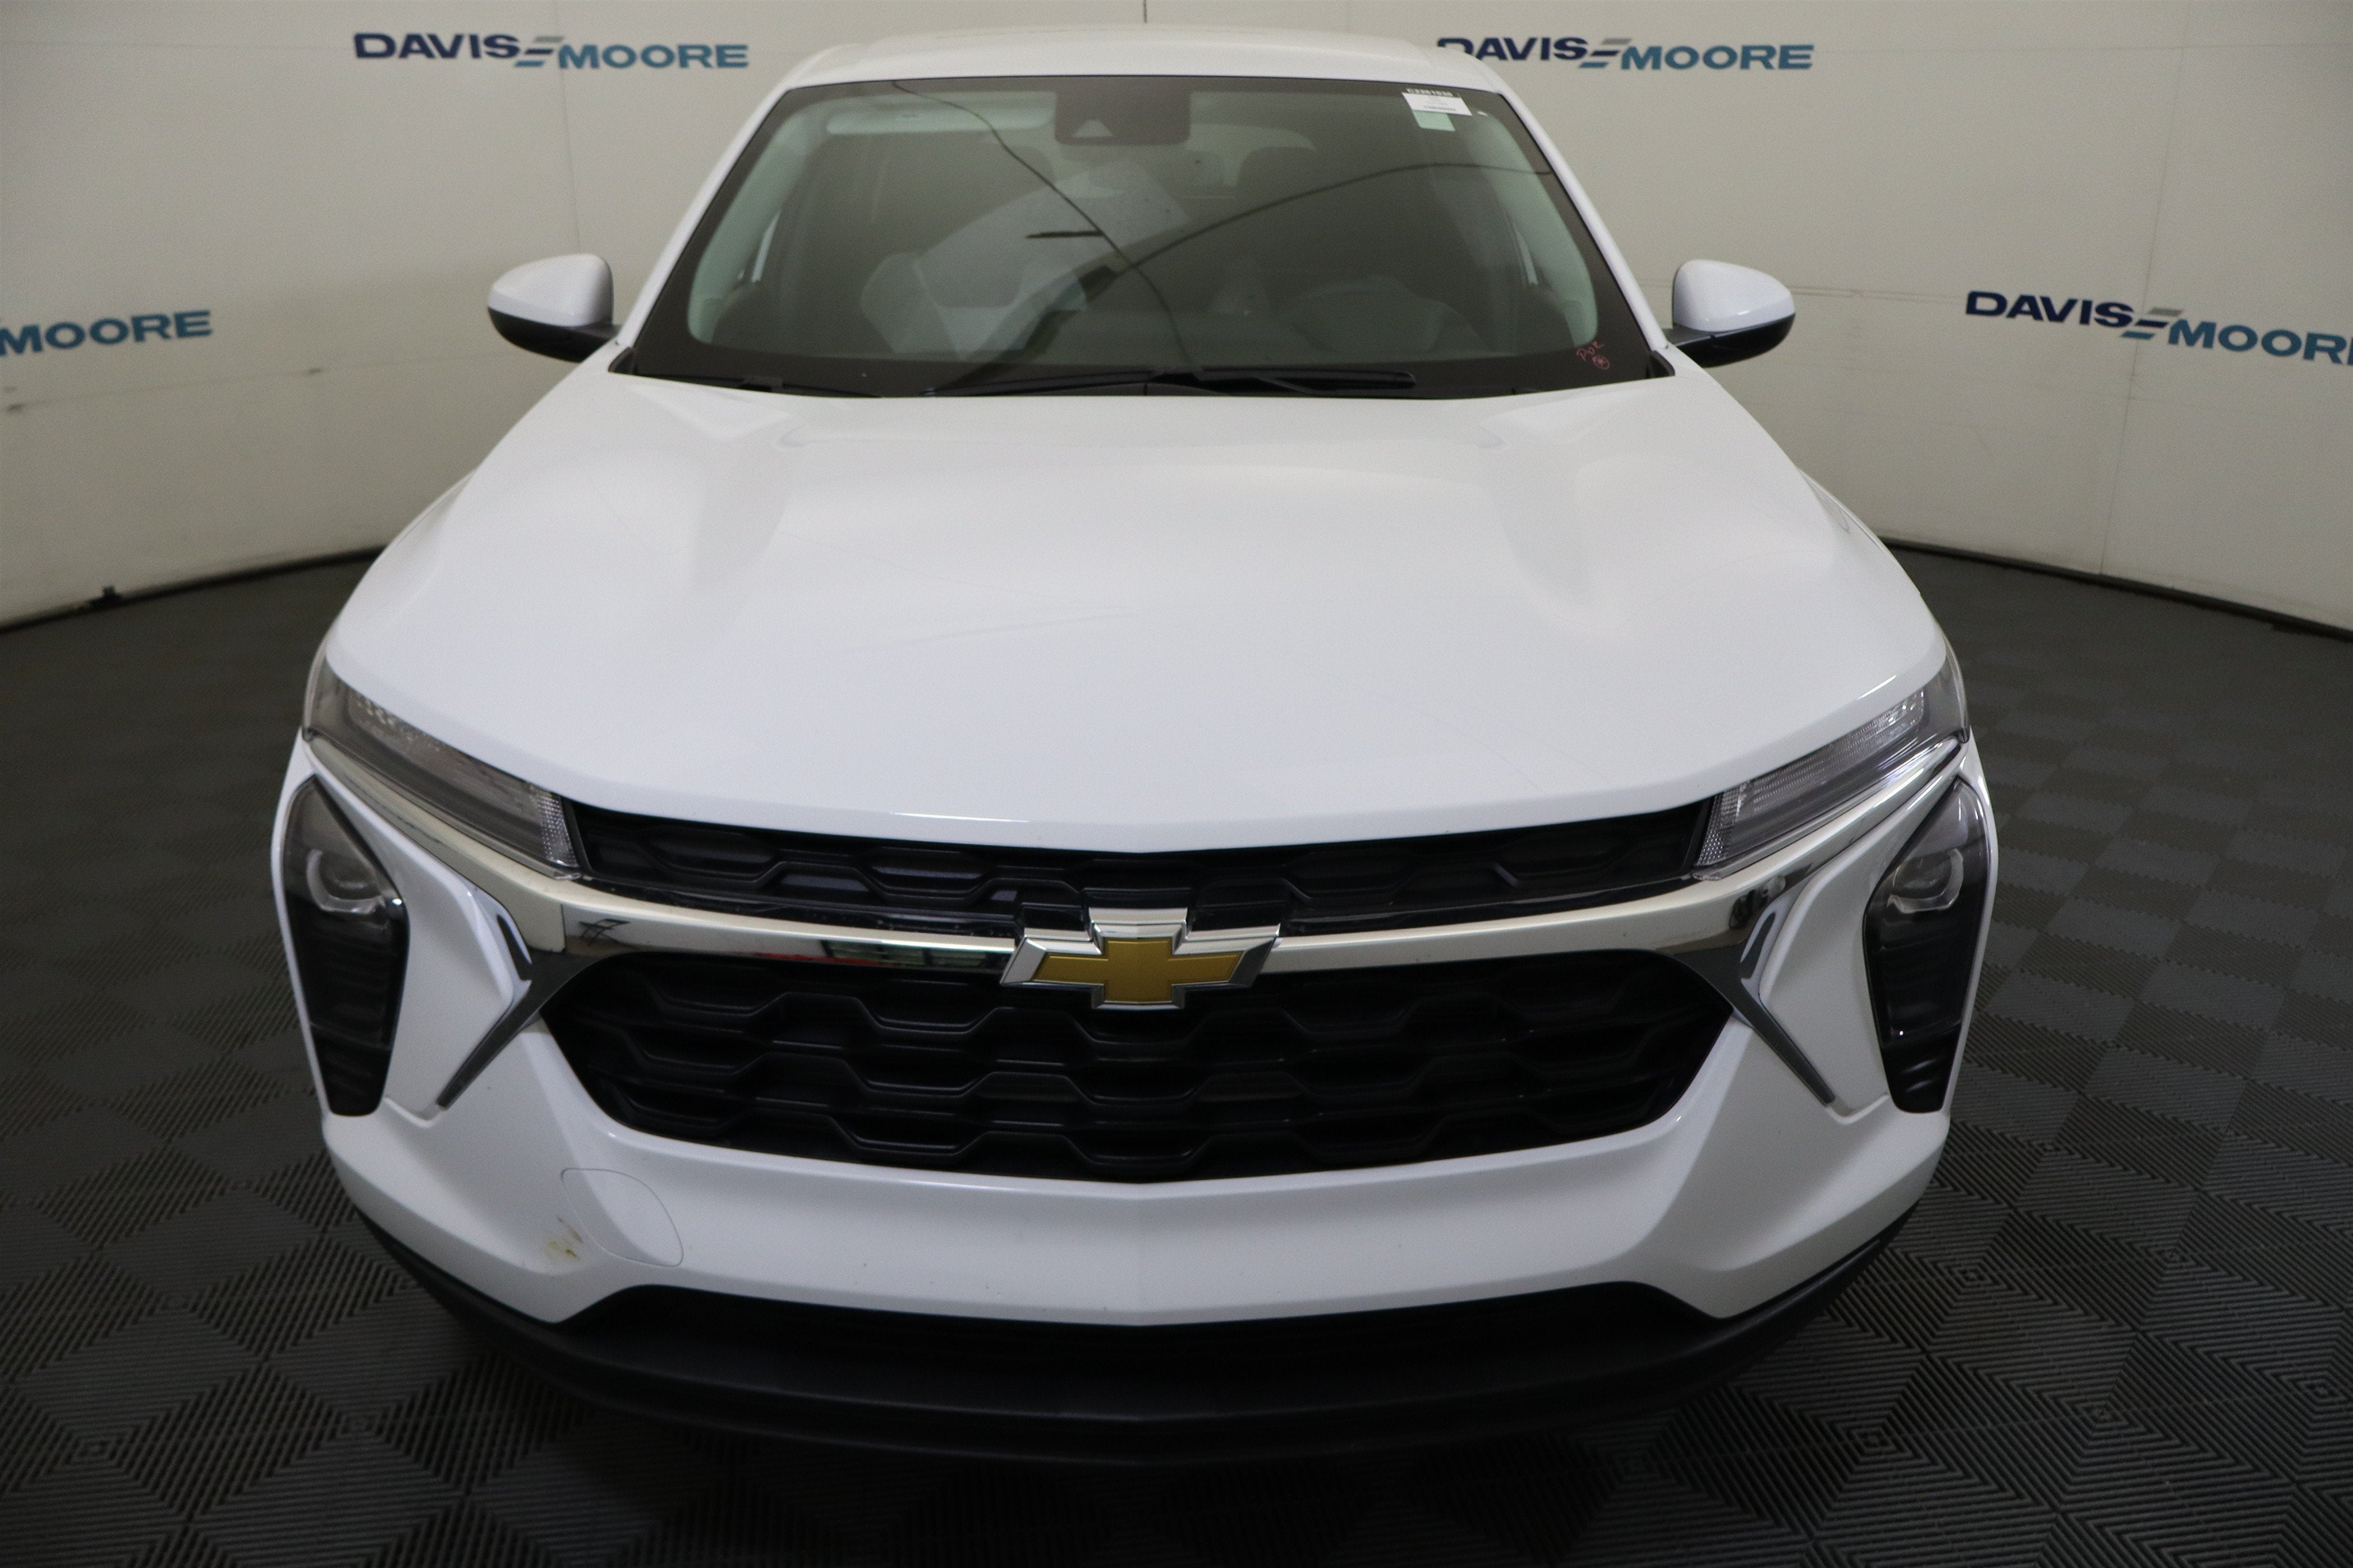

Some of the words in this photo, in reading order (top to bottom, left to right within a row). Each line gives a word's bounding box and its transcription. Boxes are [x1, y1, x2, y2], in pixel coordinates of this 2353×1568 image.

[353, 33, 521, 59] DAVIS
[558, 44, 750, 69] MOORE
[1621, 44, 1815, 70] MOORE
[0, 310, 213, 357] MOORE
[1965, 291, 2135, 327] DAVIS
[2167, 319, 2352, 366] MOOR
